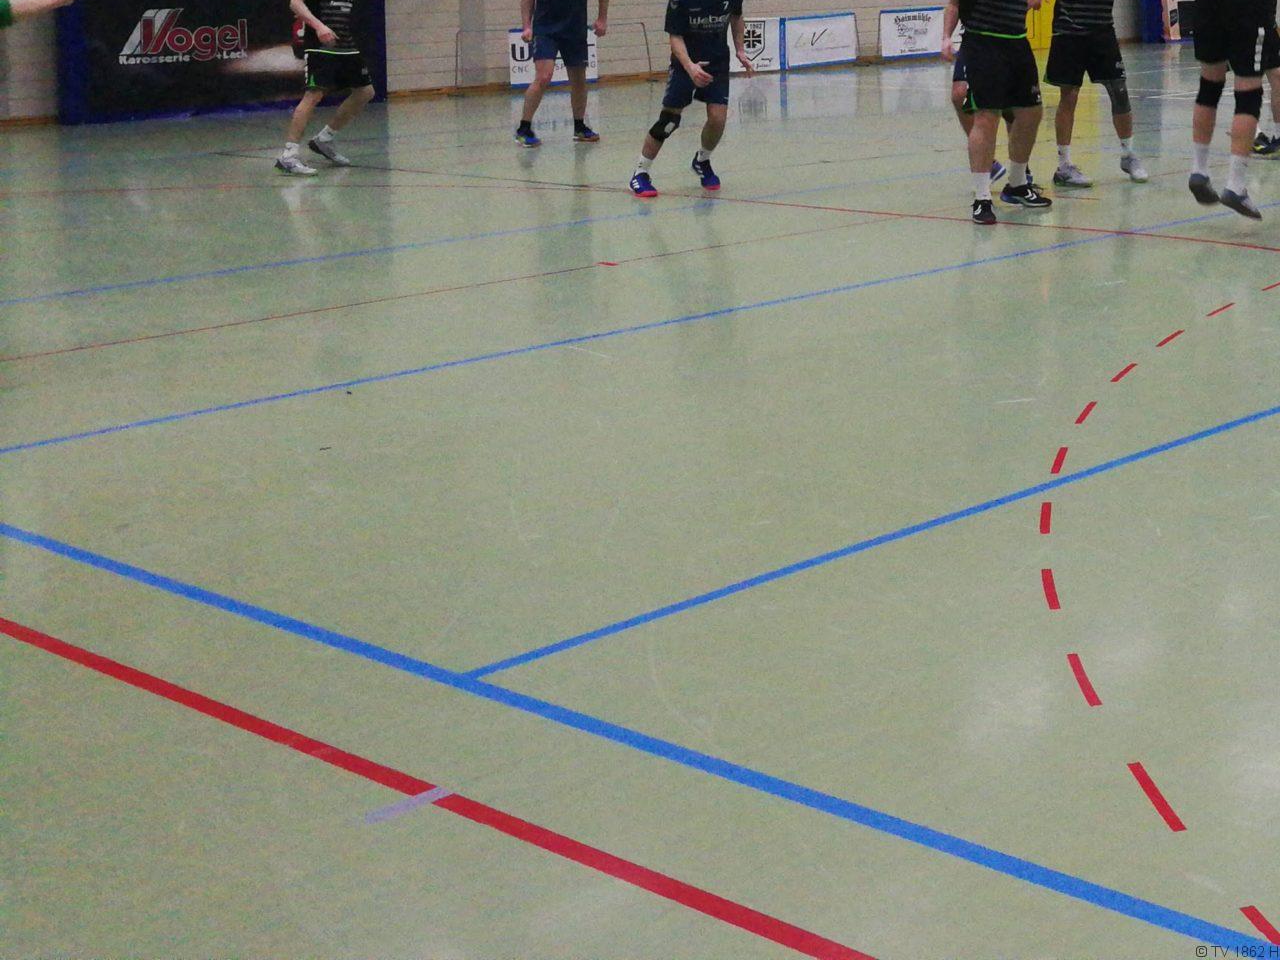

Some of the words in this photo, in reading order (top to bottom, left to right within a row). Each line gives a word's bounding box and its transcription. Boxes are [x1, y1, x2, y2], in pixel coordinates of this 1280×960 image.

[723, 1, 730, 10] 7
[141, 8, 248, 61] Vogel
[119, 54, 190, 65] Karosserie
